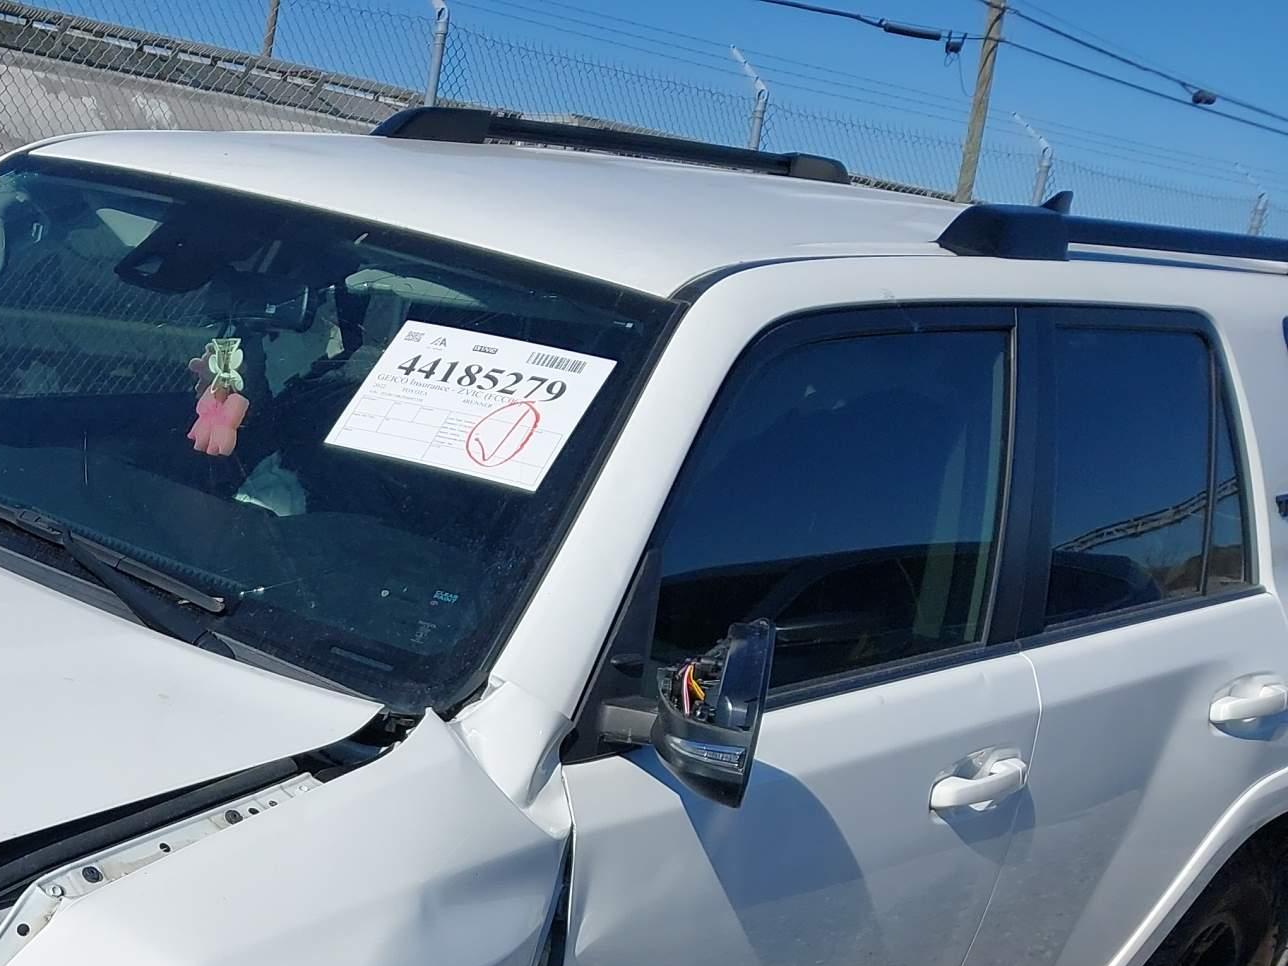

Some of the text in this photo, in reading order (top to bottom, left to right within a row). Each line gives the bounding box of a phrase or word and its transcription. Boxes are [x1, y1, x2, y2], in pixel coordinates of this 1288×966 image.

[377, 373, 409, 385] GEICO
[409, 378, 450, 392] Insurance
[397, 354, 567, 402] 44185279
